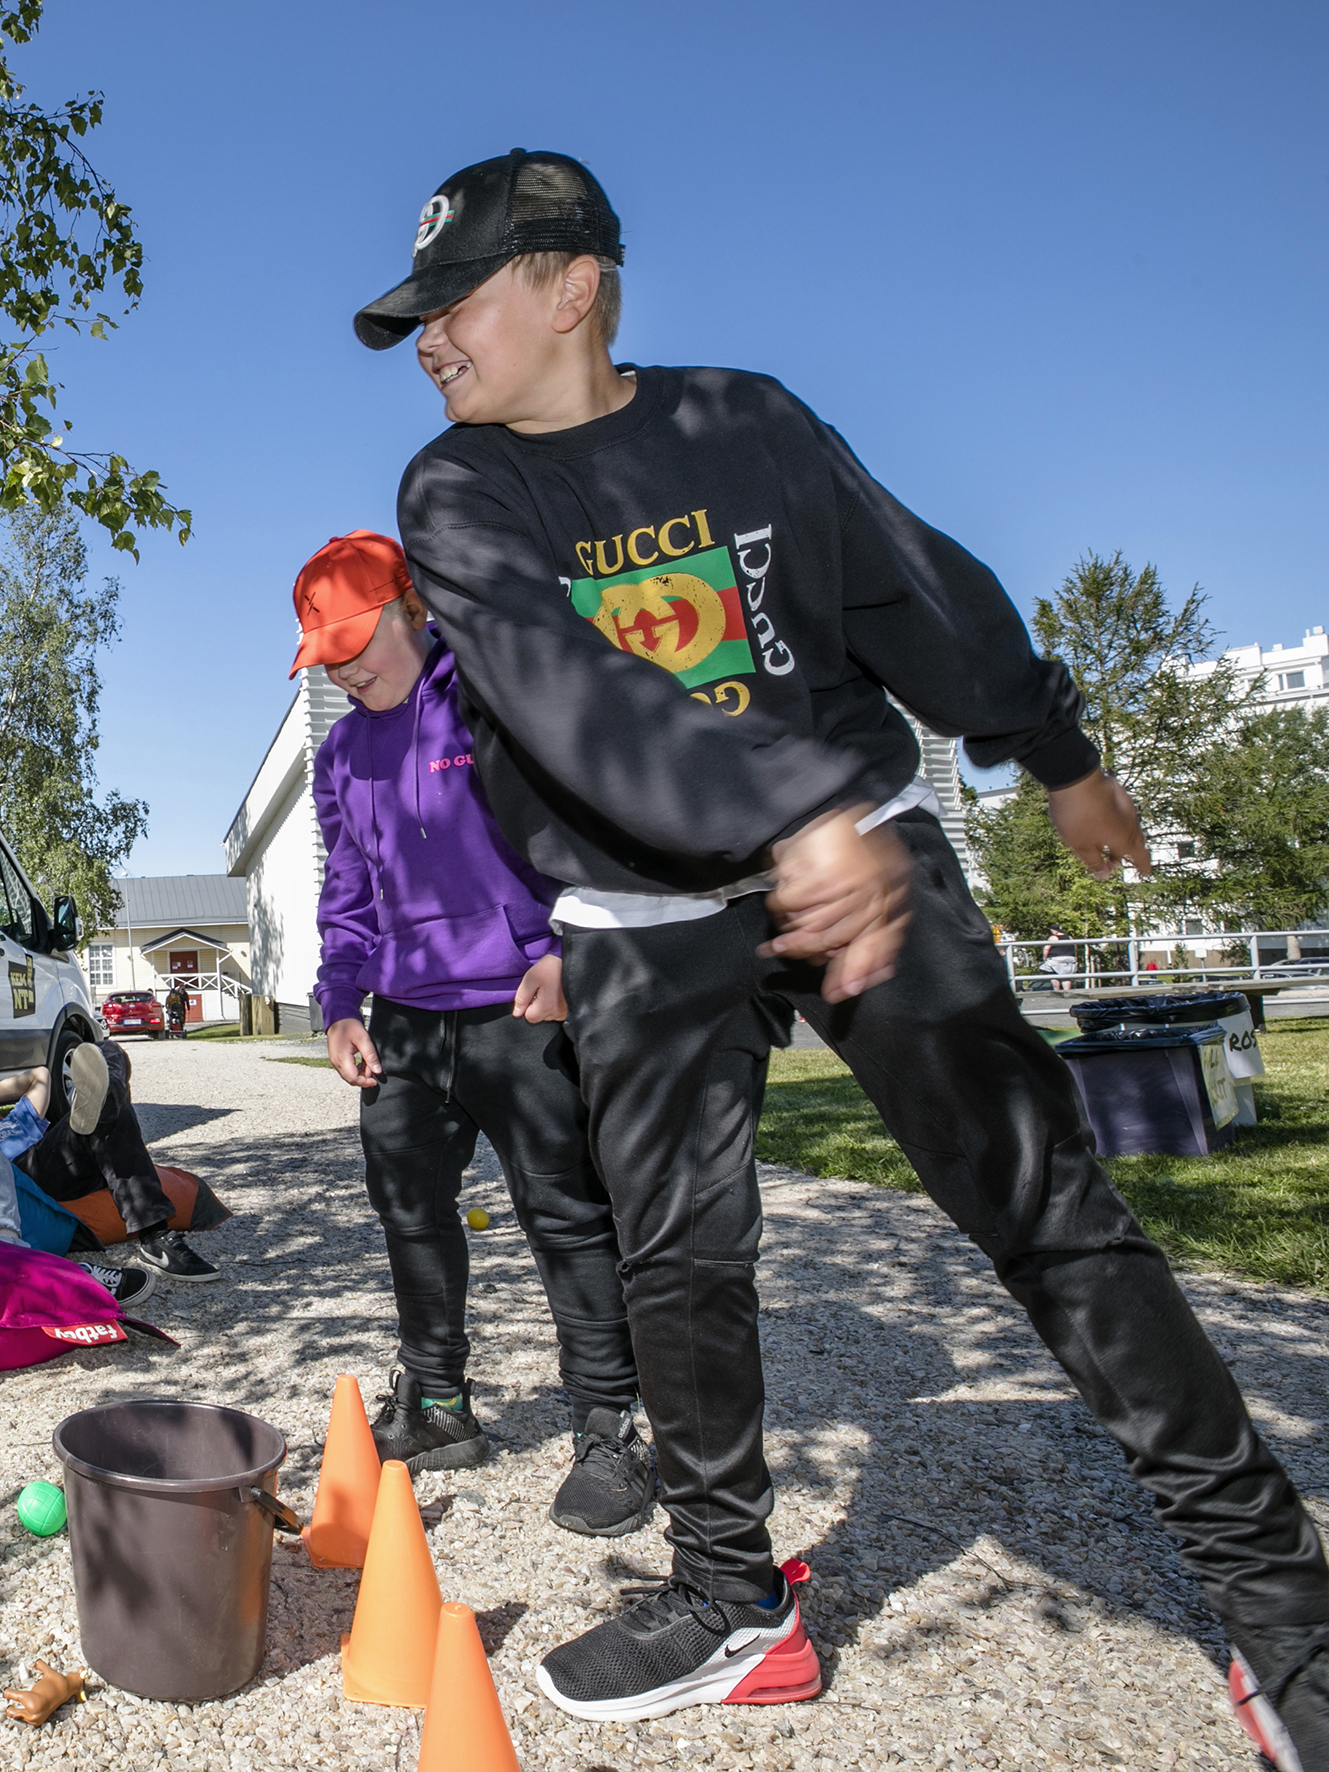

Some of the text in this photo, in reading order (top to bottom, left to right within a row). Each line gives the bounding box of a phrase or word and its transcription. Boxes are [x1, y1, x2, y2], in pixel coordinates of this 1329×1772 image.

[733, 523, 796, 677] GUCCI
[428, 758, 451, 773] NO
[1229, 1028, 1257, 1053] ROS
[54, 1323, 118, 1344] fatboy
